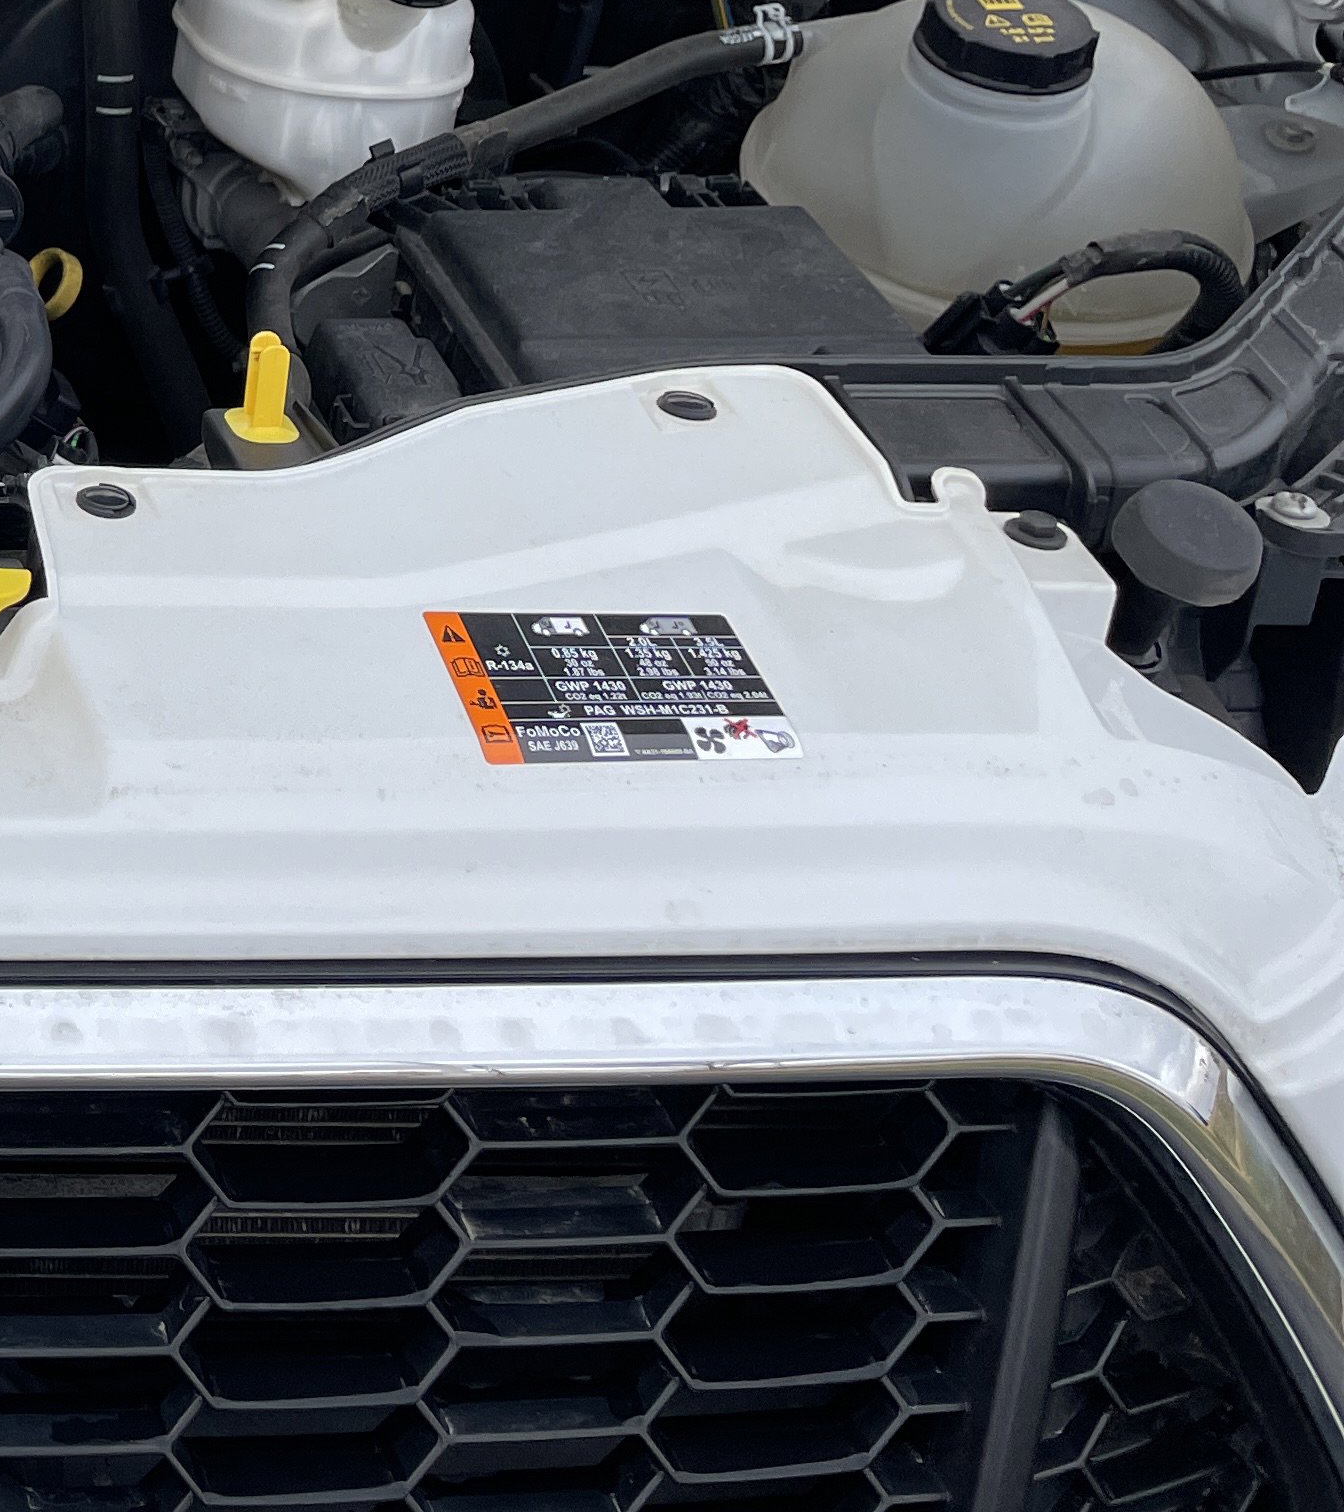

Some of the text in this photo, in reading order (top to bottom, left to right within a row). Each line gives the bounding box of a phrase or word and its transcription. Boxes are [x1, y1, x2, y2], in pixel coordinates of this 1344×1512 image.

[626, 637, 657, 647] 2.0L
[551, 648, 599, 661] 0.85 kg
[624, 648, 672, 661] 1.35 kg
[723, 648, 742, 661] kg
[485, 660, 534, 671] R-134a
[587, 668, 605, 676] lbs
[662, 667, 679, 676] lbs
[728, 667, 746, 676] lbs
[555, 681, 627, 691] GWP 1430
[662, 680, 733, 691] GWP 1430
[641, 691, 663, 699] CO2
[707, 691, 729, 699] CO2
[584, 704, 730, 716] PAG WSH-M1C231-B
[515, 725, 581, 738] FoMoCo
[528, 740, 580, 752] SAE J639
